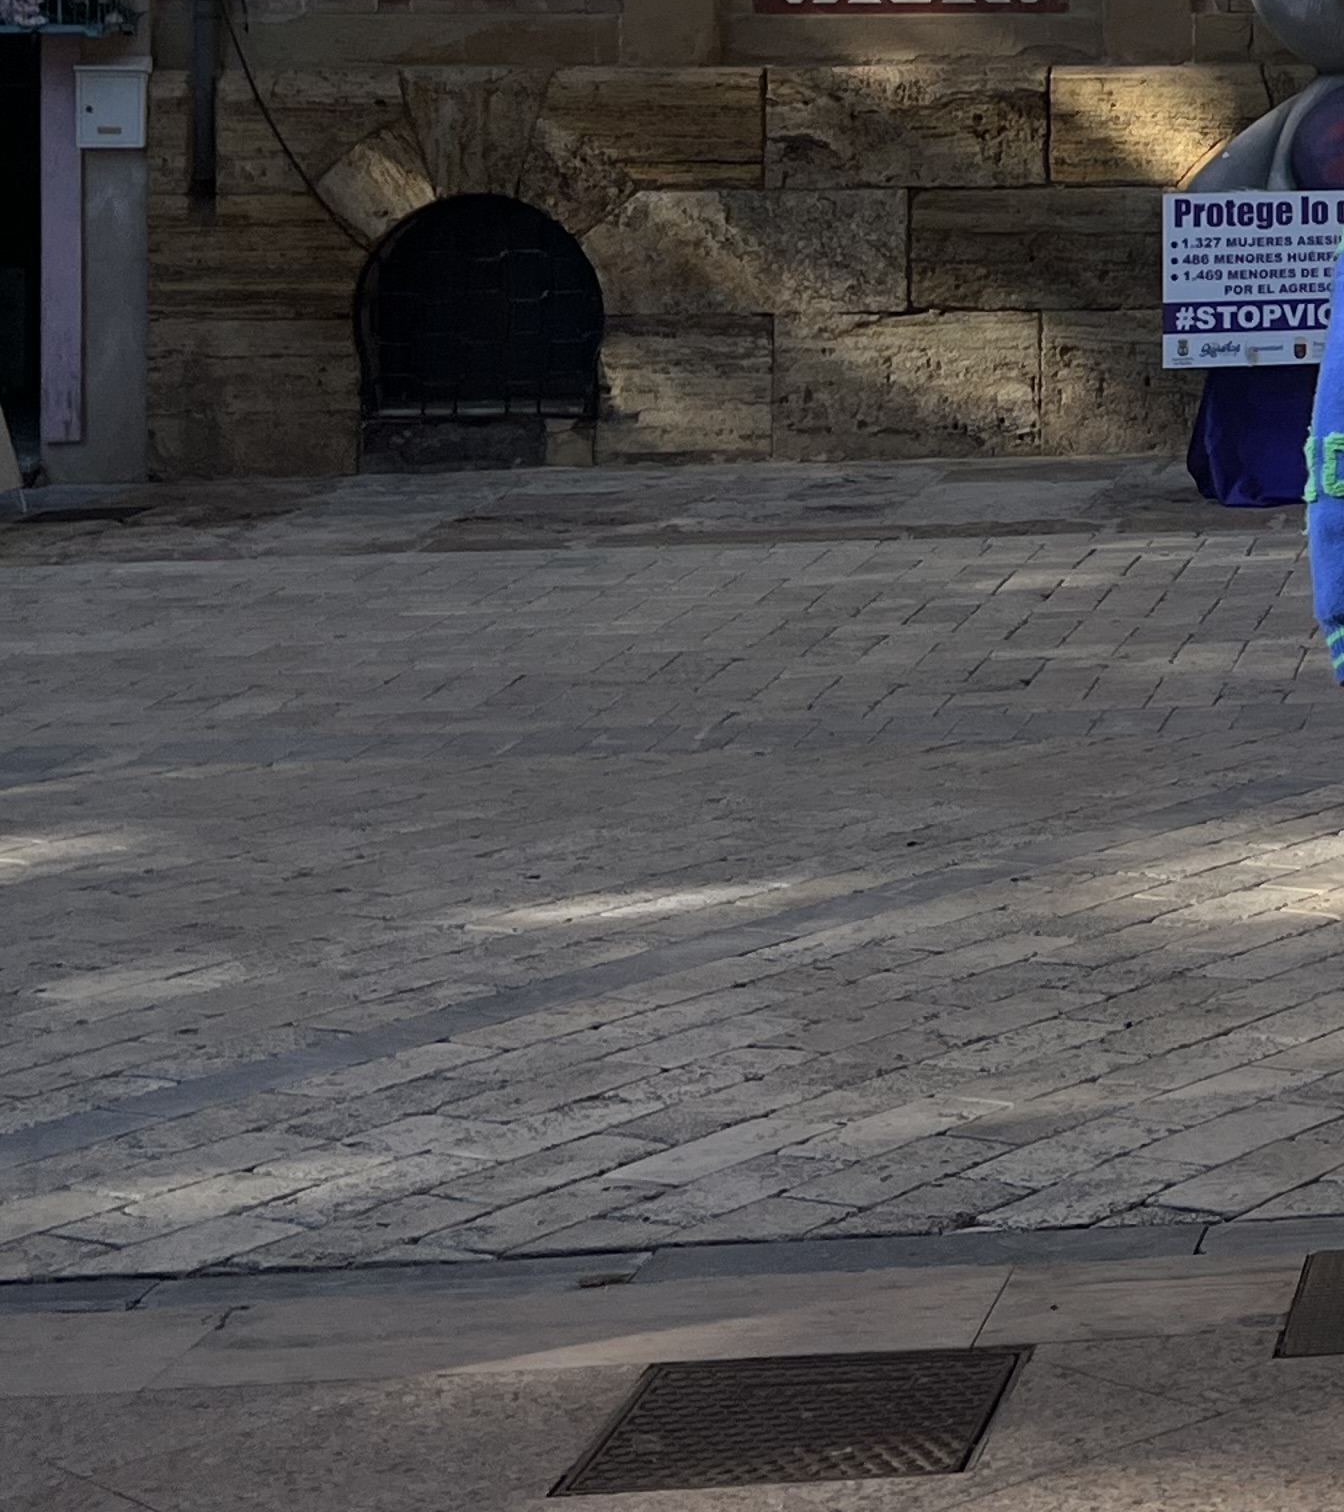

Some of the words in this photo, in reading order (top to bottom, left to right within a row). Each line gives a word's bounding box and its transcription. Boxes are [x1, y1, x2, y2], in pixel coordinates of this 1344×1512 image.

[1174, 199, 1292, 230] Protege
[1301, 196, 1328, 225] lo
[1226, 236, 1292, 247] MUJERES
[1214, 253, 1282, 264] MENORES
[1228, 268, 1296, 280] MENORES
[1301, 268, 1320, 278] DE
[1224, 284, 1253, 295] POR
[1258, 284, 1275, 294] EL
